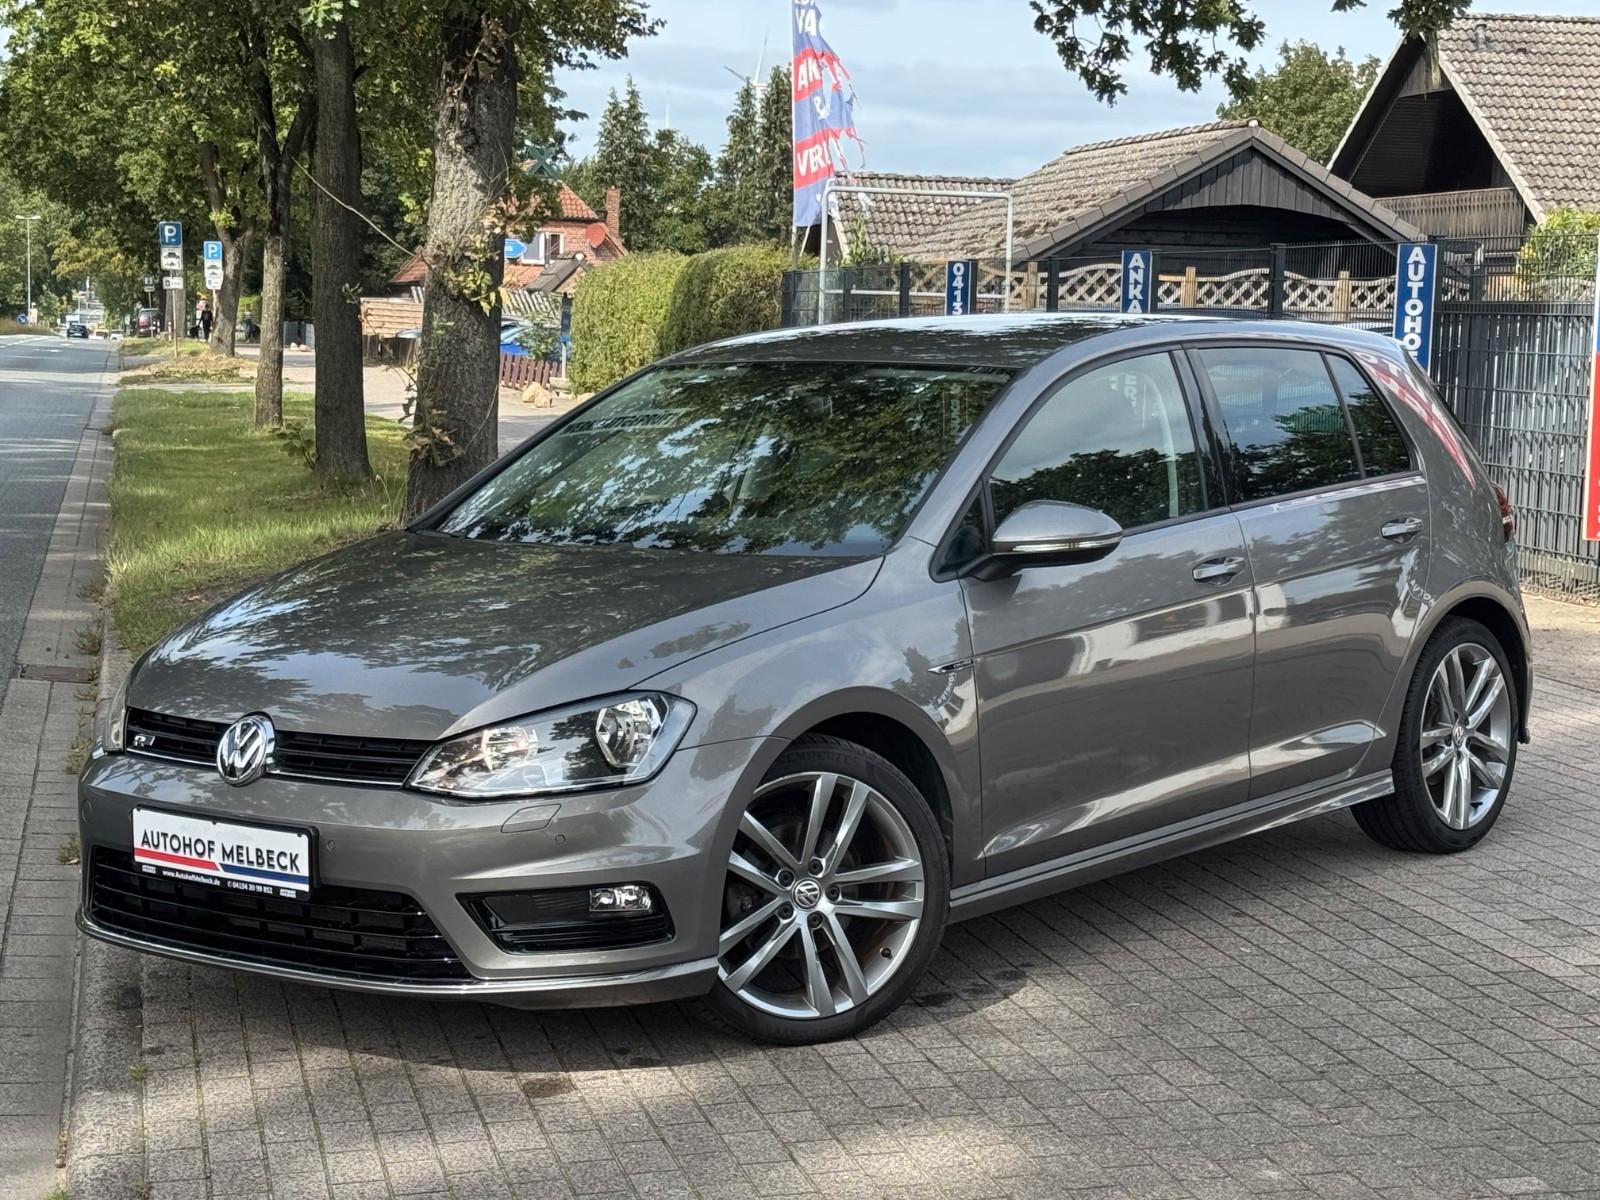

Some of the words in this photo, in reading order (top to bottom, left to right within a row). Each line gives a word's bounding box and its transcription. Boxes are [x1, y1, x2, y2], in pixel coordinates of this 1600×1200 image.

[164, 225, 176, 243] P
[208, 244, 218, 258] P
[141, 829, 215, 859] AUTOHOF
[221, 842, 301, 873] MELBECK
